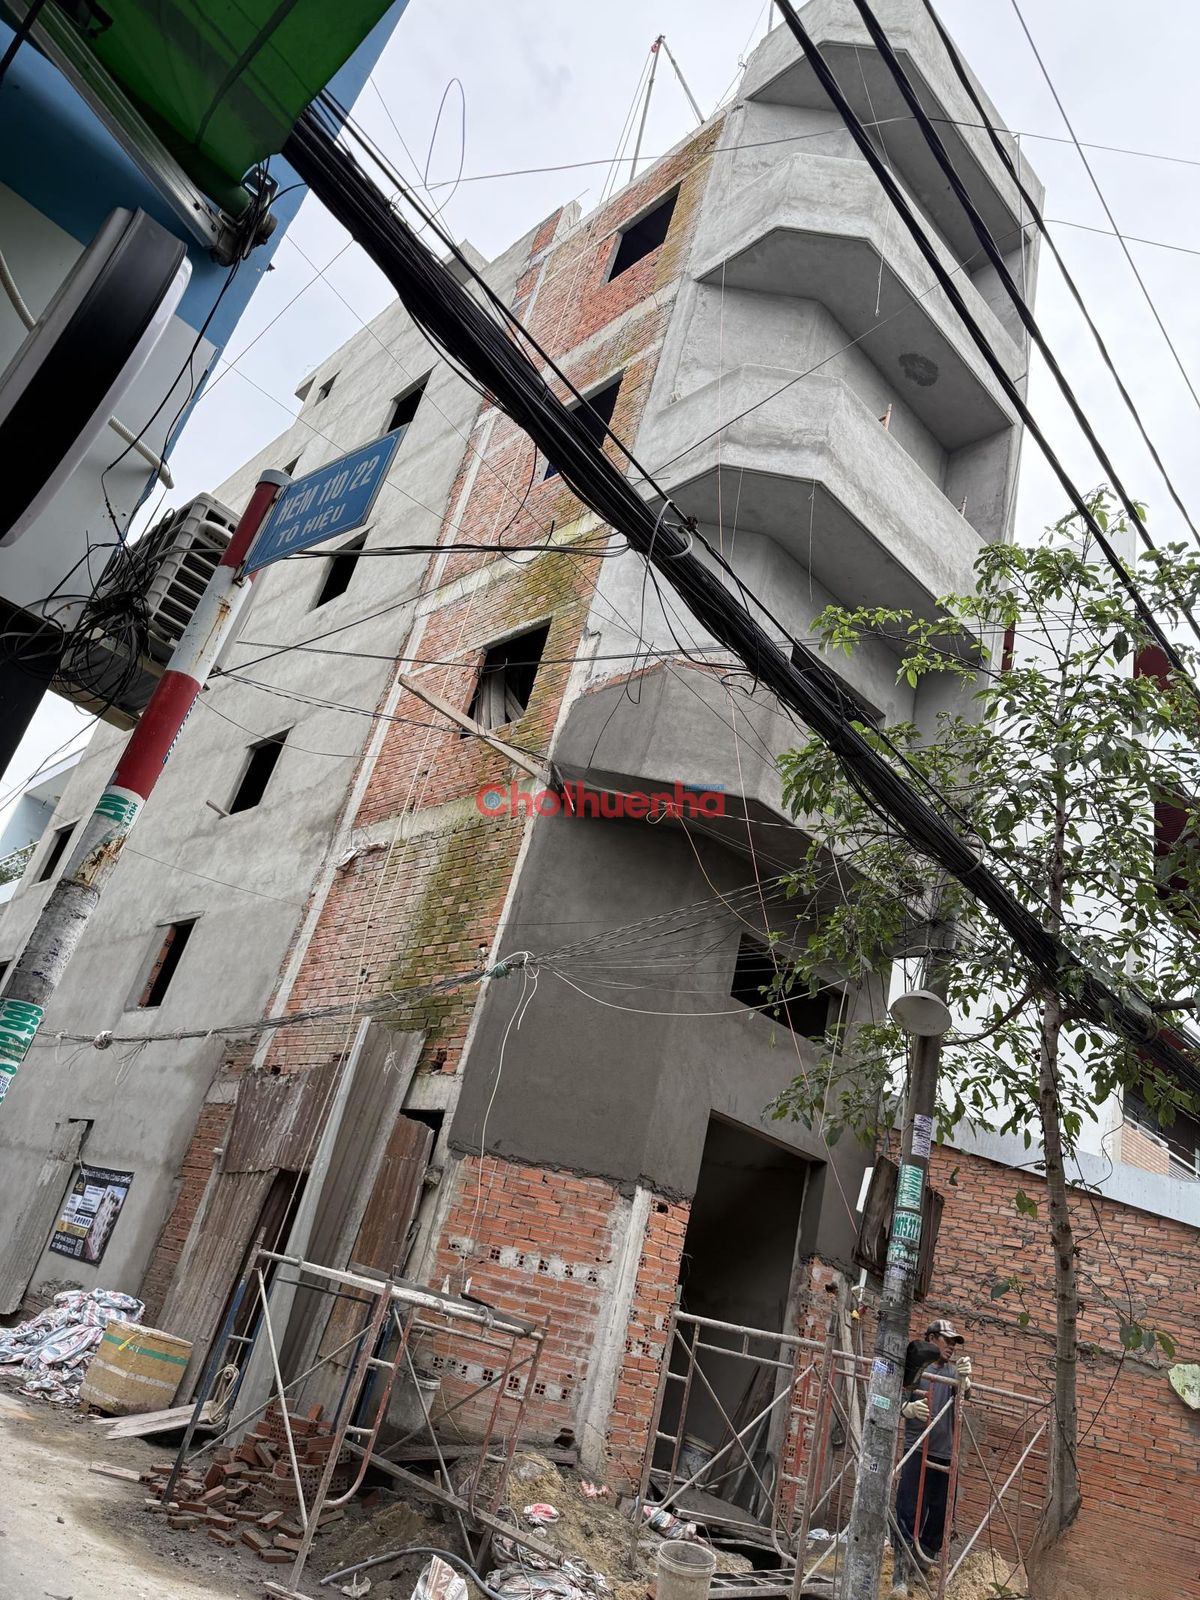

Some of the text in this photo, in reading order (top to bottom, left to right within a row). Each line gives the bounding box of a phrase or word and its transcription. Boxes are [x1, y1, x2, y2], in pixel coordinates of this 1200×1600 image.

[318, 455, 380, 506] 110/22
[276, 503, 347, 547] TÔ HIỆU
